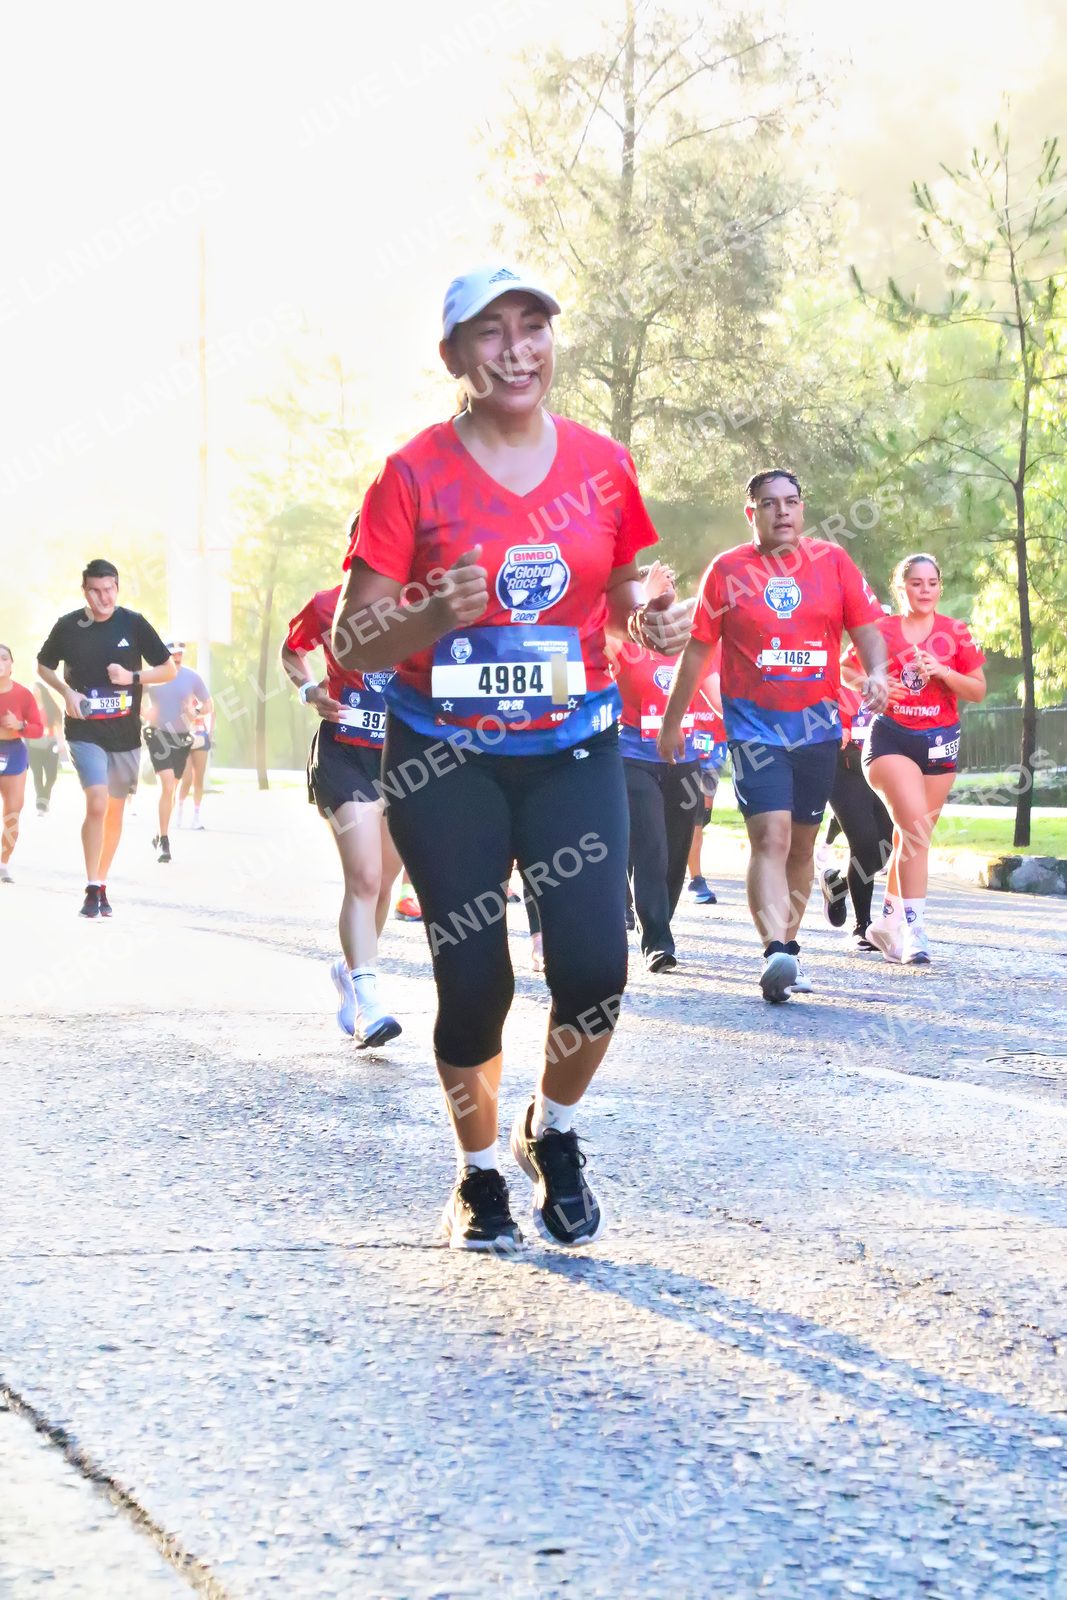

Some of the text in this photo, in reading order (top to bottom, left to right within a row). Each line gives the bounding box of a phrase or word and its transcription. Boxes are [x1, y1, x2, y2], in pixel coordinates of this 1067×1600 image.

[513, 551, 553, 562] BIMBO
[514, 564, 552, 579] Global
[507, 577, 538, 589] Race
[784, 651, 811, 665] 1462
[478, 665, 544, 694] 4984
